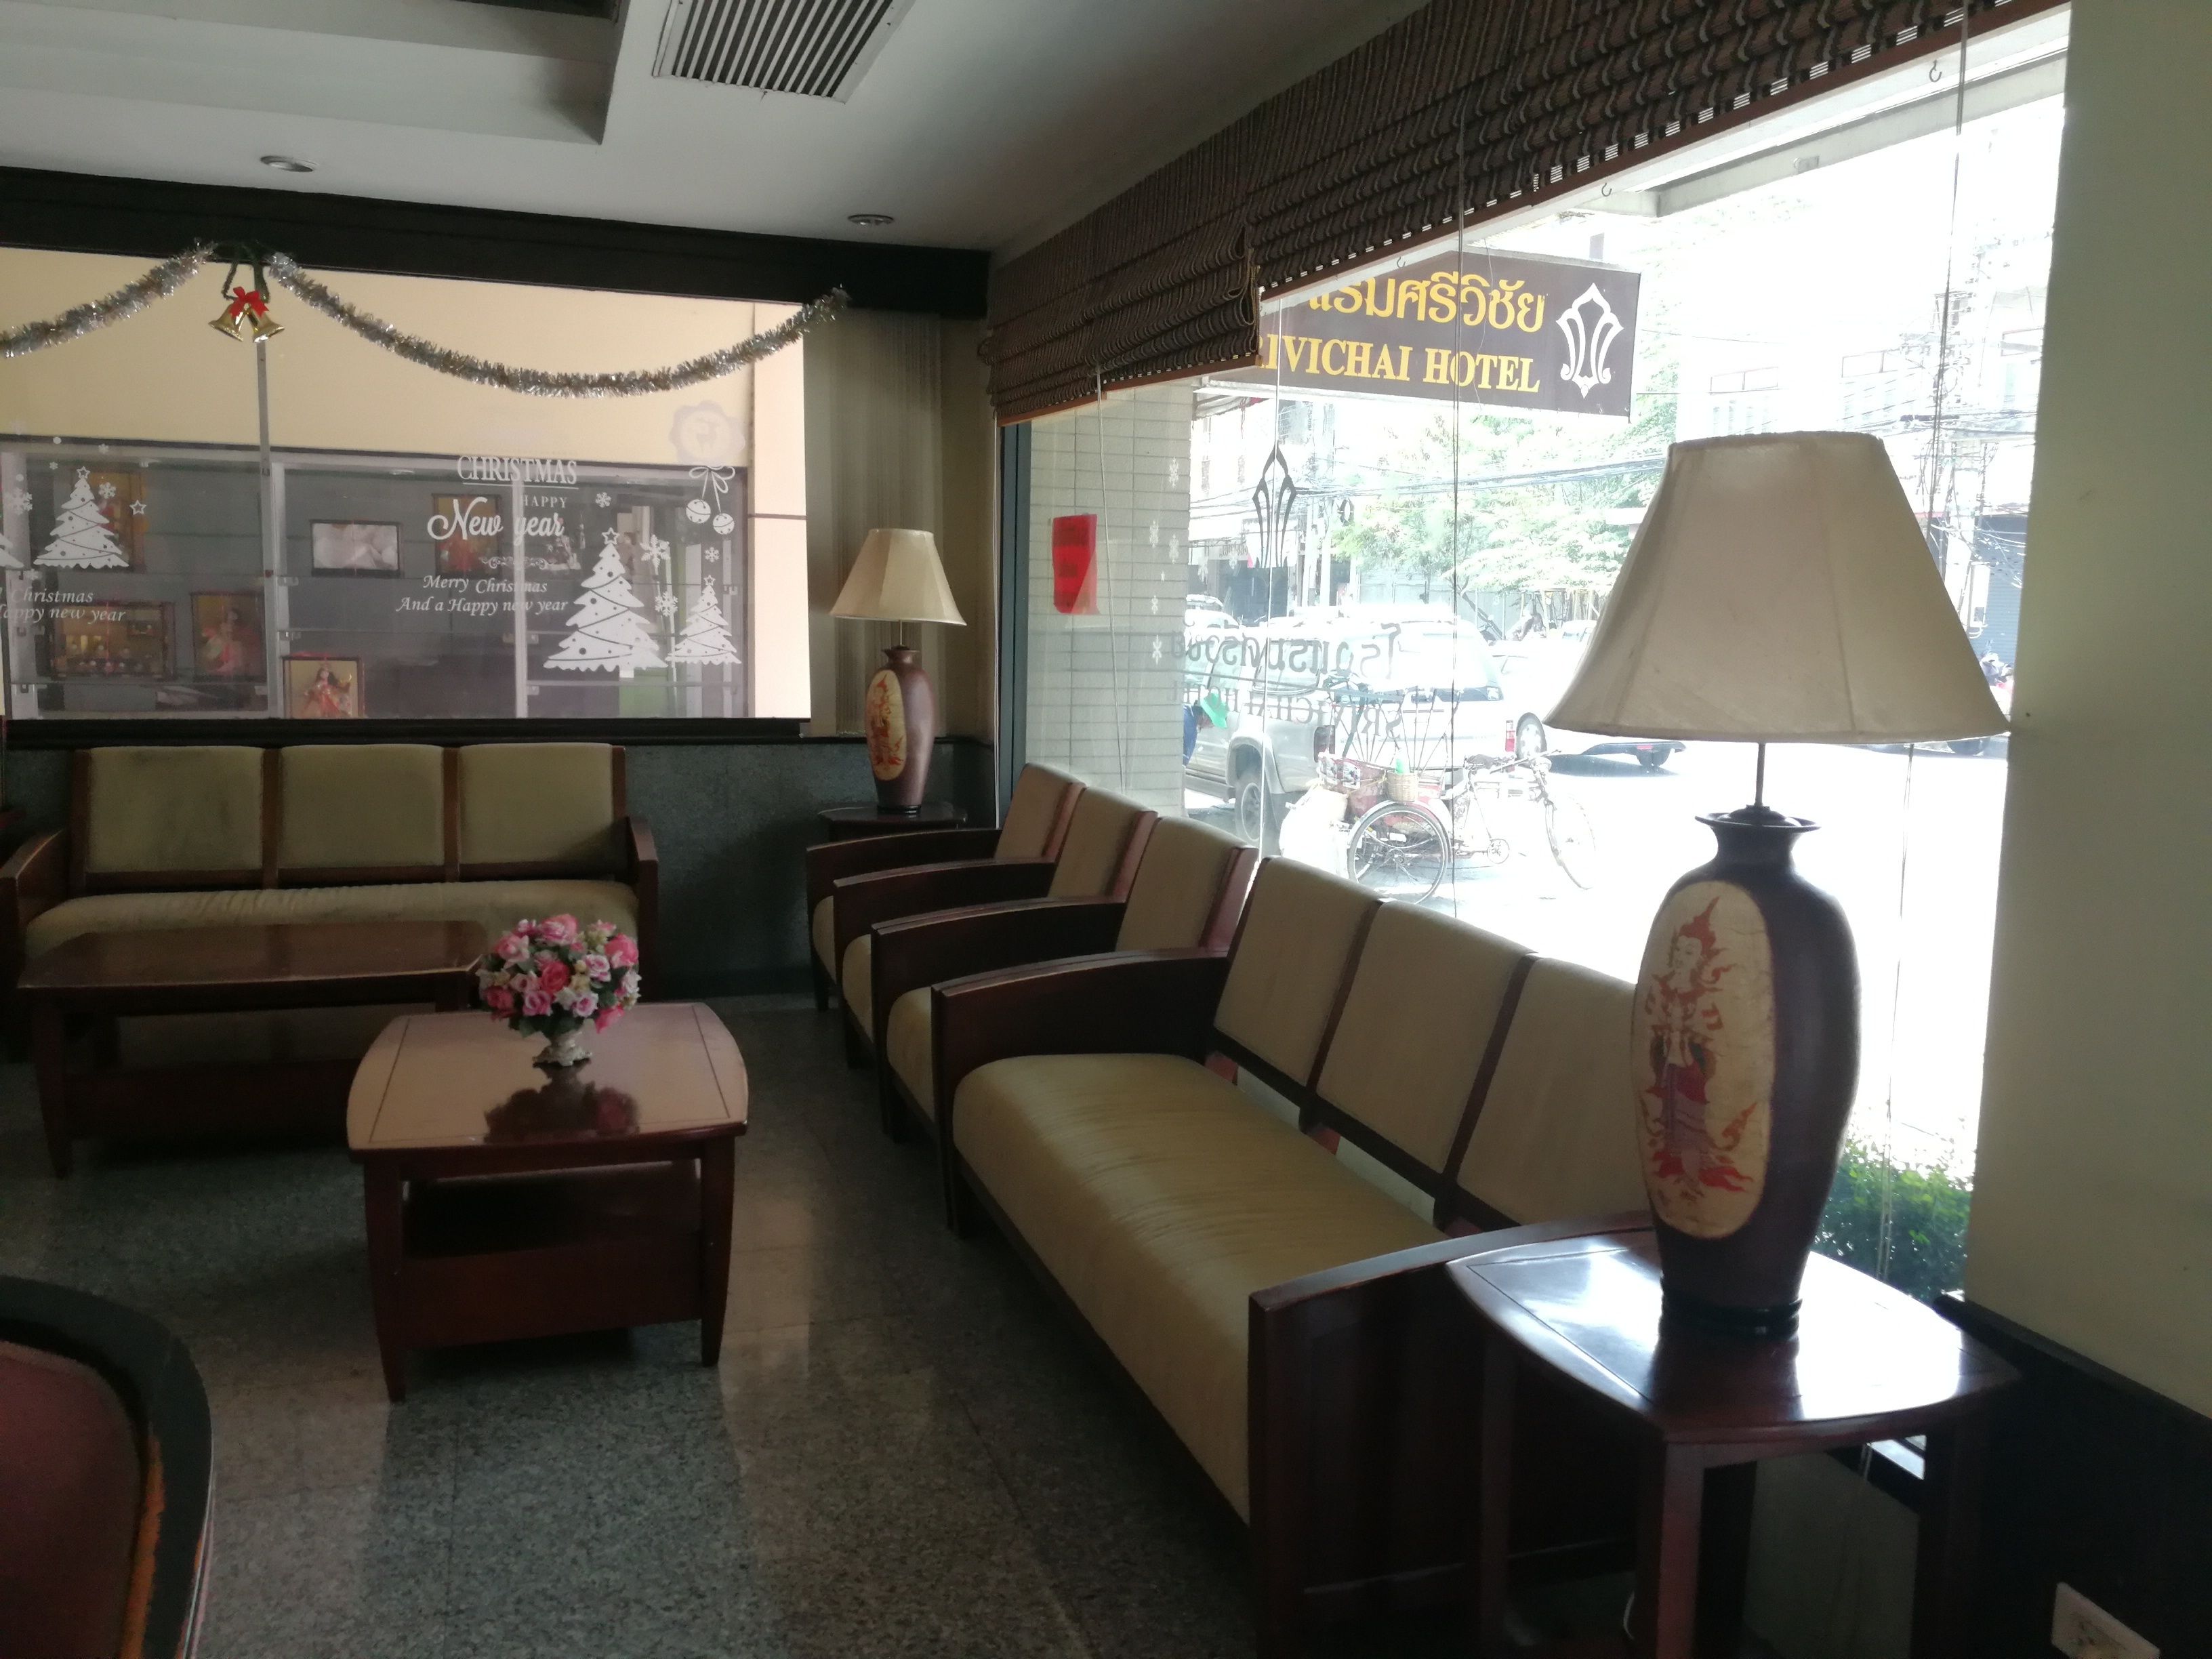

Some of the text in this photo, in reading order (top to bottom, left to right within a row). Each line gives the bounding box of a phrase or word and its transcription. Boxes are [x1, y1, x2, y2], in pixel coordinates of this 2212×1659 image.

[1422, 348, 1540, 393] HOTEL
[457, 455, 577, 485] CHRISTMAS
[521, 493, 568, 508] HAPPY
[428, 497, 565, 546] New year
[423, 575, 469, 593] Merry
[12, 586, 94, 602] Christmas
[396, 596, 434, 612] And
[435, 602, 445, 611] a
[448, 598, 498, 616] Happy
[535, 601, 569, 615] year
[50, 607, 85, 619] new
[87, 609, 127, 625] year
